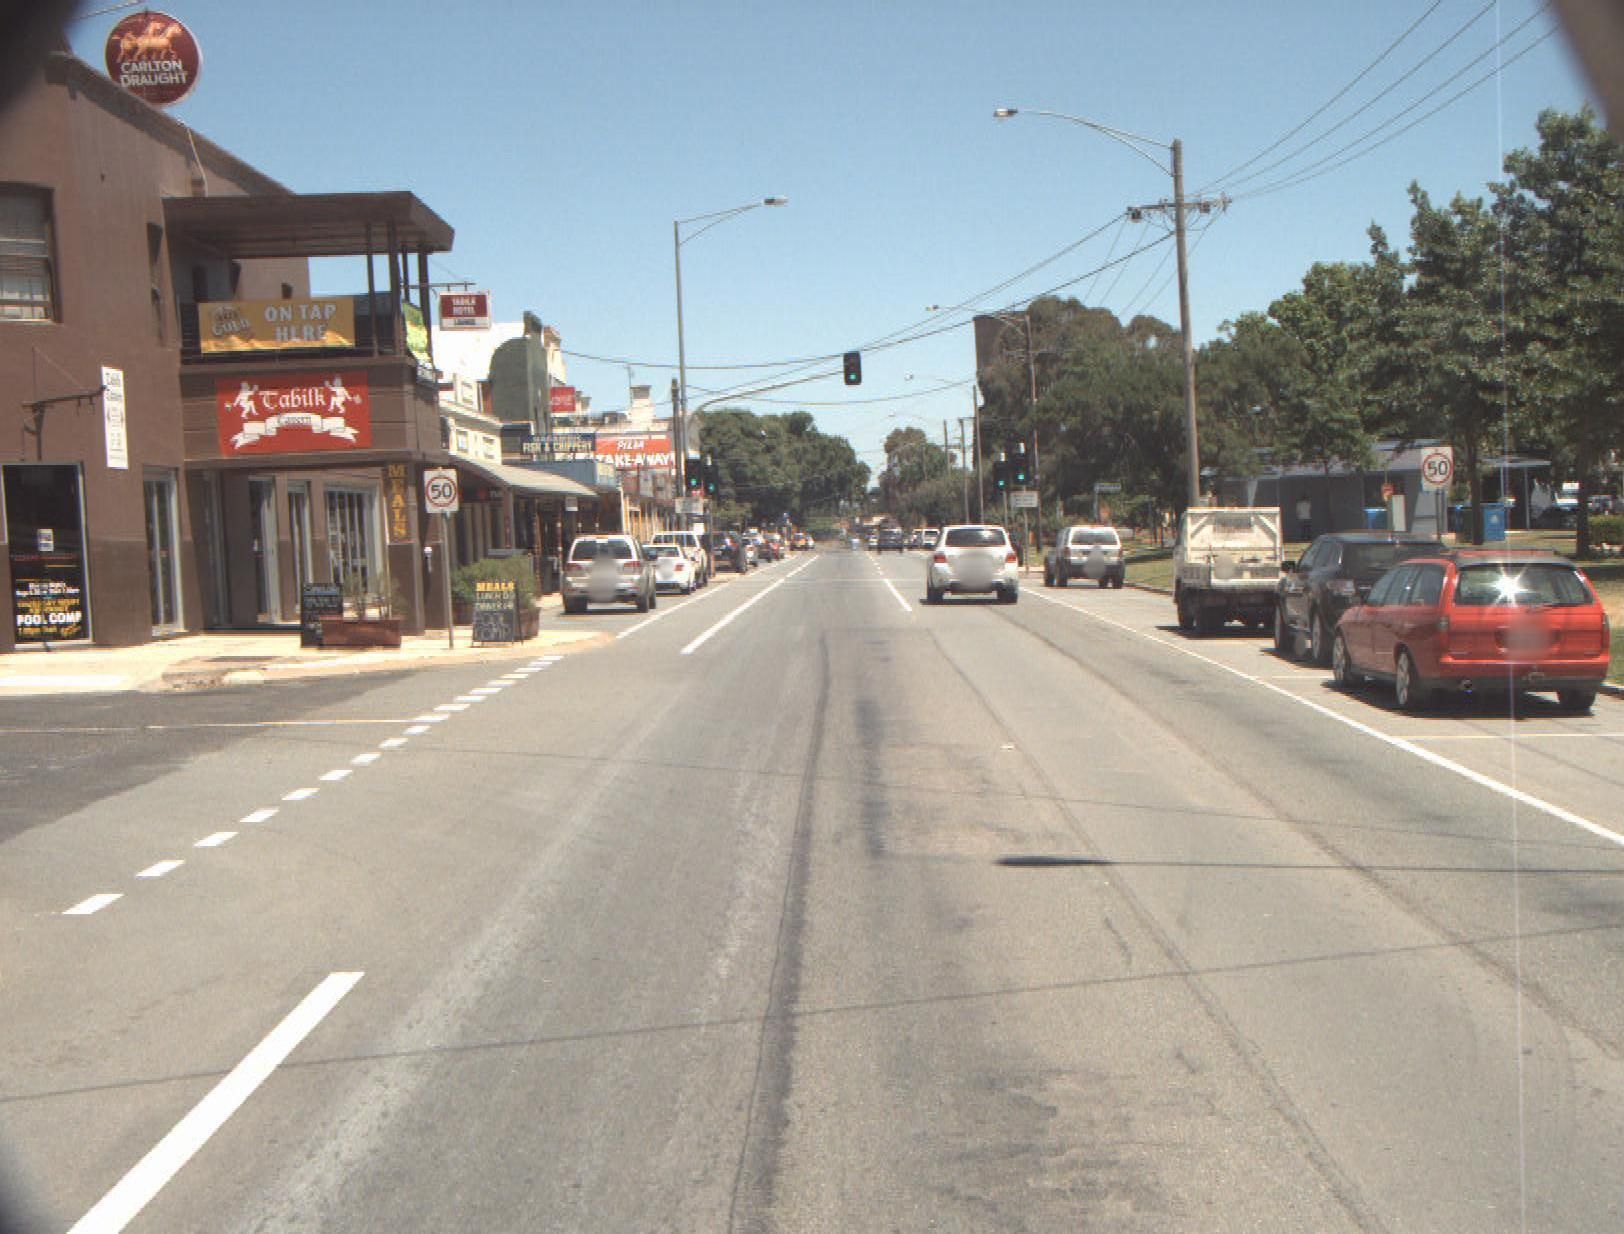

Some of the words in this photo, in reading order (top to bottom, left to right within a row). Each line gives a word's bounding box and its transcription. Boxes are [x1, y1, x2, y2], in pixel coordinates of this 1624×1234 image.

[120, 60, 182, 73] CARLTON
[120, 71, 188, 87] DRAUGHT
[264, 304, 293, 321] ON
[299, 303, 337, 320] TAP
[275, 324, 328, 341] HERE
[257, 386, 327, 410] Tabilk
[1427, 460, 1448, 477] 50
[430, 482, 453, 499] 50
[16, 614, 48, 626] POOL
[48, 611, 82, 623] COMP
